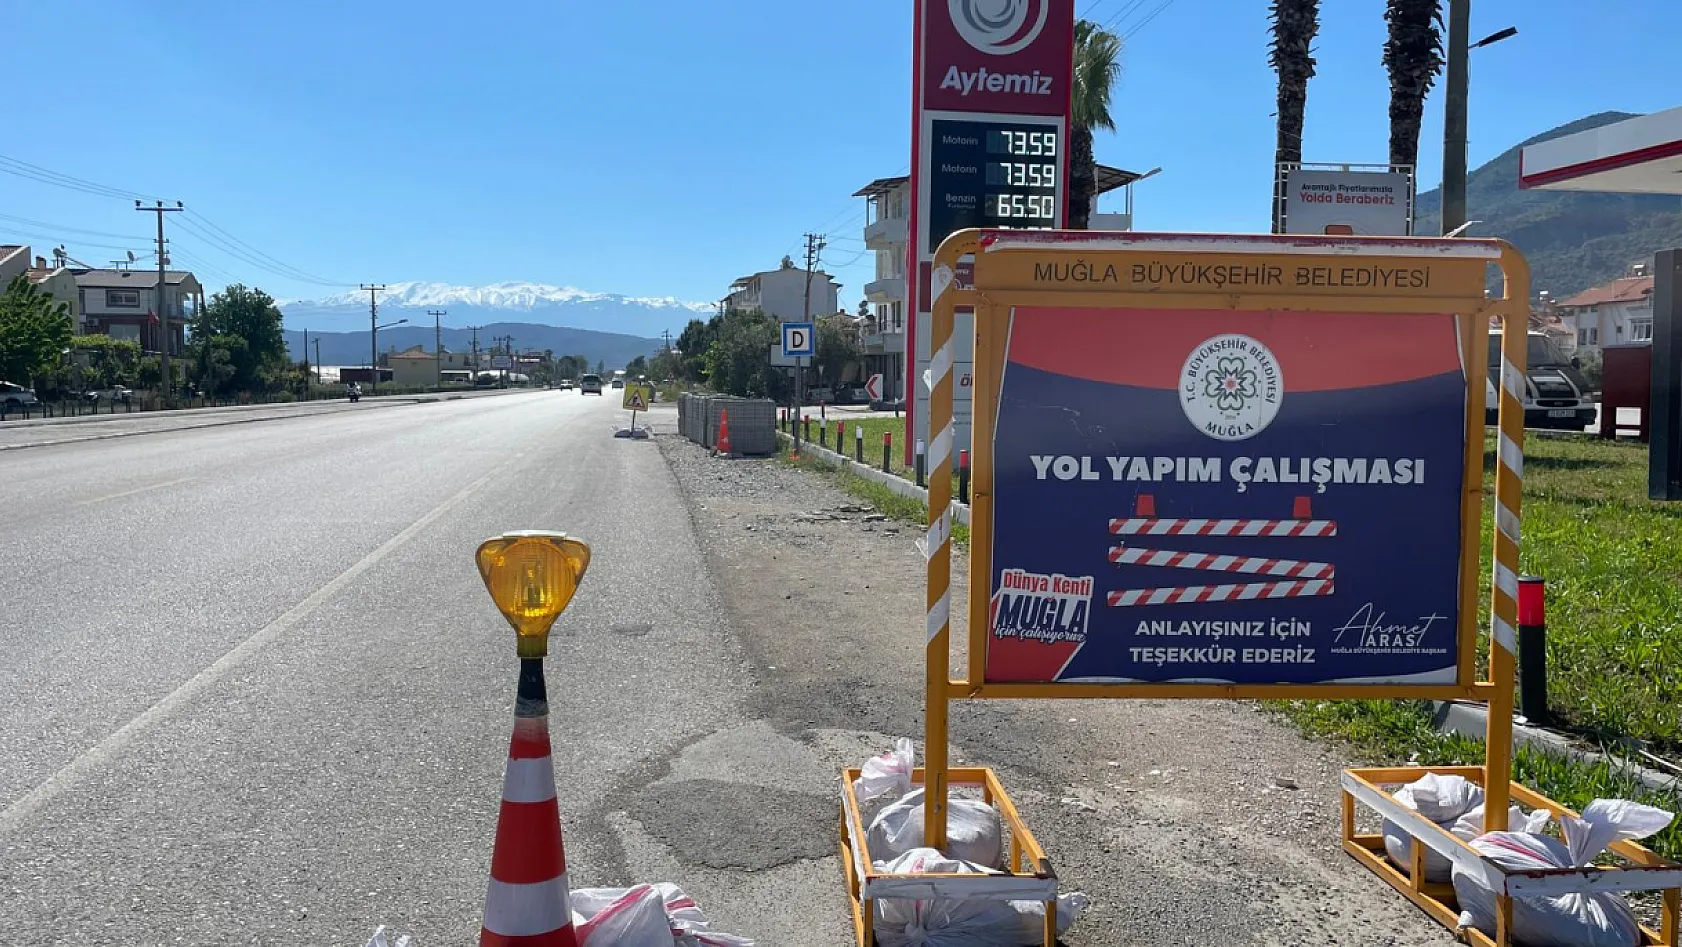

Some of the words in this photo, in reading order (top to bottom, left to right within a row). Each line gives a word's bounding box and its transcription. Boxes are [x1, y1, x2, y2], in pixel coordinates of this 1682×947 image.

[940, 65, 1053, 96] Aytemiz
[942, 135, 979, 146] Motorin
[1000, 130, 1056, 156] 73.59
[941, 163, 978, 174] Motorin
[999, 162, 1055, 187] 73.59
[945, 193, 976, 203] Benzin
[998, 194, 1055, 218] 65.50
[1300, 192, 1332, 203] Yolda
[1336, 192, 1395, 205] Beraberiz
[1034, 259, 1118, 283] MUĞLA
[1132, 261, 1282, 288] BÜYÜKŞEHİR
[1296, 265, 1430, 288] BELEDİYESİ
[792, 331, 804, 348] D
[1186, 381, 1196, 403] T.C.
[1205, 421, 1254, 436] MUĞLA
[1029, 455, 1100, 481] YOL
[1106, 456, 1222, 482] YAPIM
[1229, 456, 1425, 493] ÇALIŞMASI
[1003, 572, 1048, 593] Dünya
[1053, 576, 1091, 596] Kenti
[996, 594, 1088, 634] MUĞLA
[1332, 602, 1448, 646] Ahmet
[995, 624, 1017, 639] için
[1135, 620, 1264, 640] ANLAYIŞINIZ
[1269, 616, 1311, 641] İÇİN
[1365, 634, 1415, 647] ARAS
[1129, 644, 1236, 667] TEŞEKKÜR
[1242, 644, 1316, 663] EDERİZ
